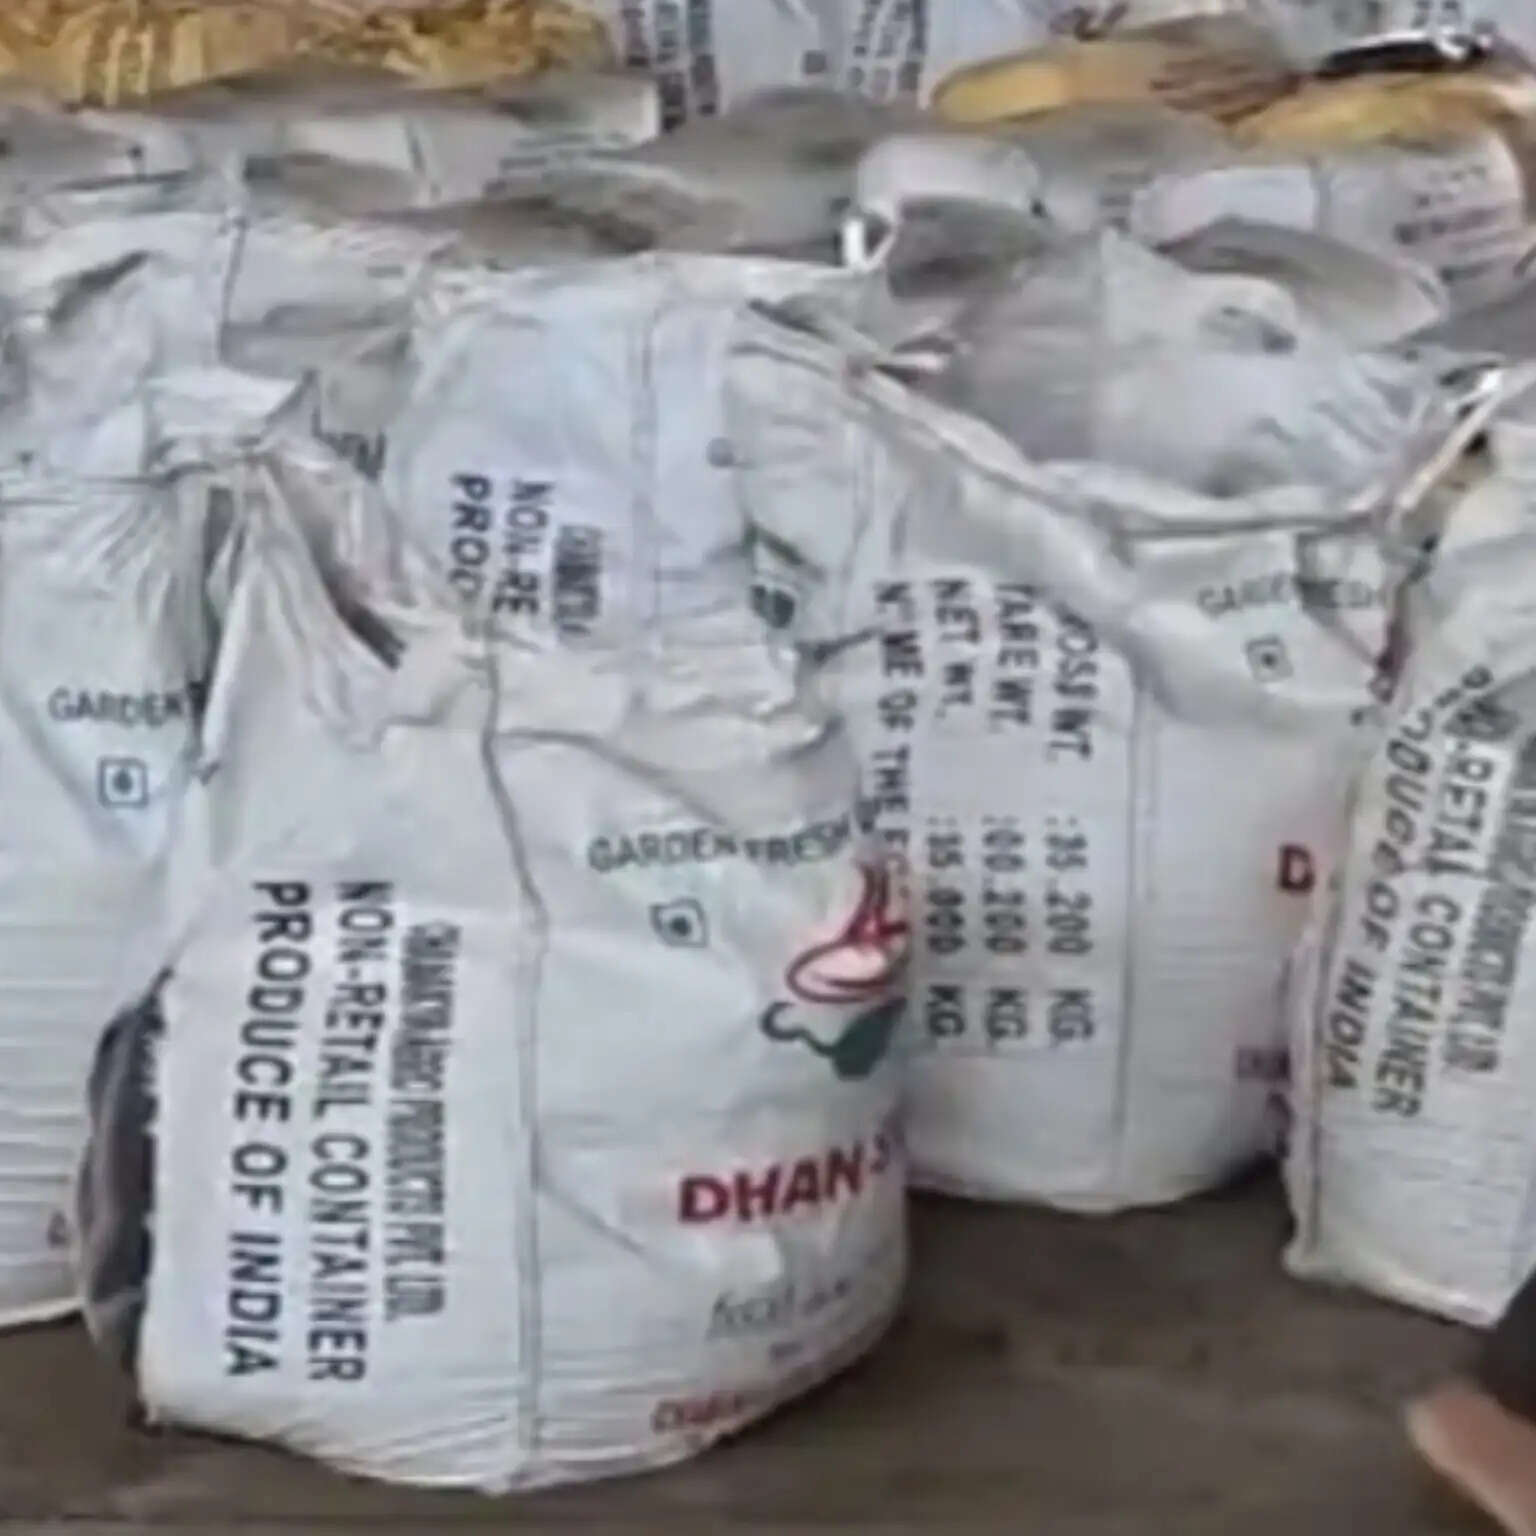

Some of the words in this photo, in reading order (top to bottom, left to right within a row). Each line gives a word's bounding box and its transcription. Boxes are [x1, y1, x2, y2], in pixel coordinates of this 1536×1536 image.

[932, 578, 979, 644] NET
[881, 689, 917, 730] OF
[1362, 882, 1400, 952] OF
[234, 881, 313, 1121] PRODUCE
[315, 880, 395, 1119] NON-RETAIL
[1325, 960, 1377, 1090] INDIA
[1373, 895, 1463, 1117] CONTAINER
[232, 1143, 286, 1212] OF
[679, 1140, 865, 1222] DHAN
[224, 1232, 282, 1375] INDIA
[306, 1133, 369, 1381] CONTAINER
